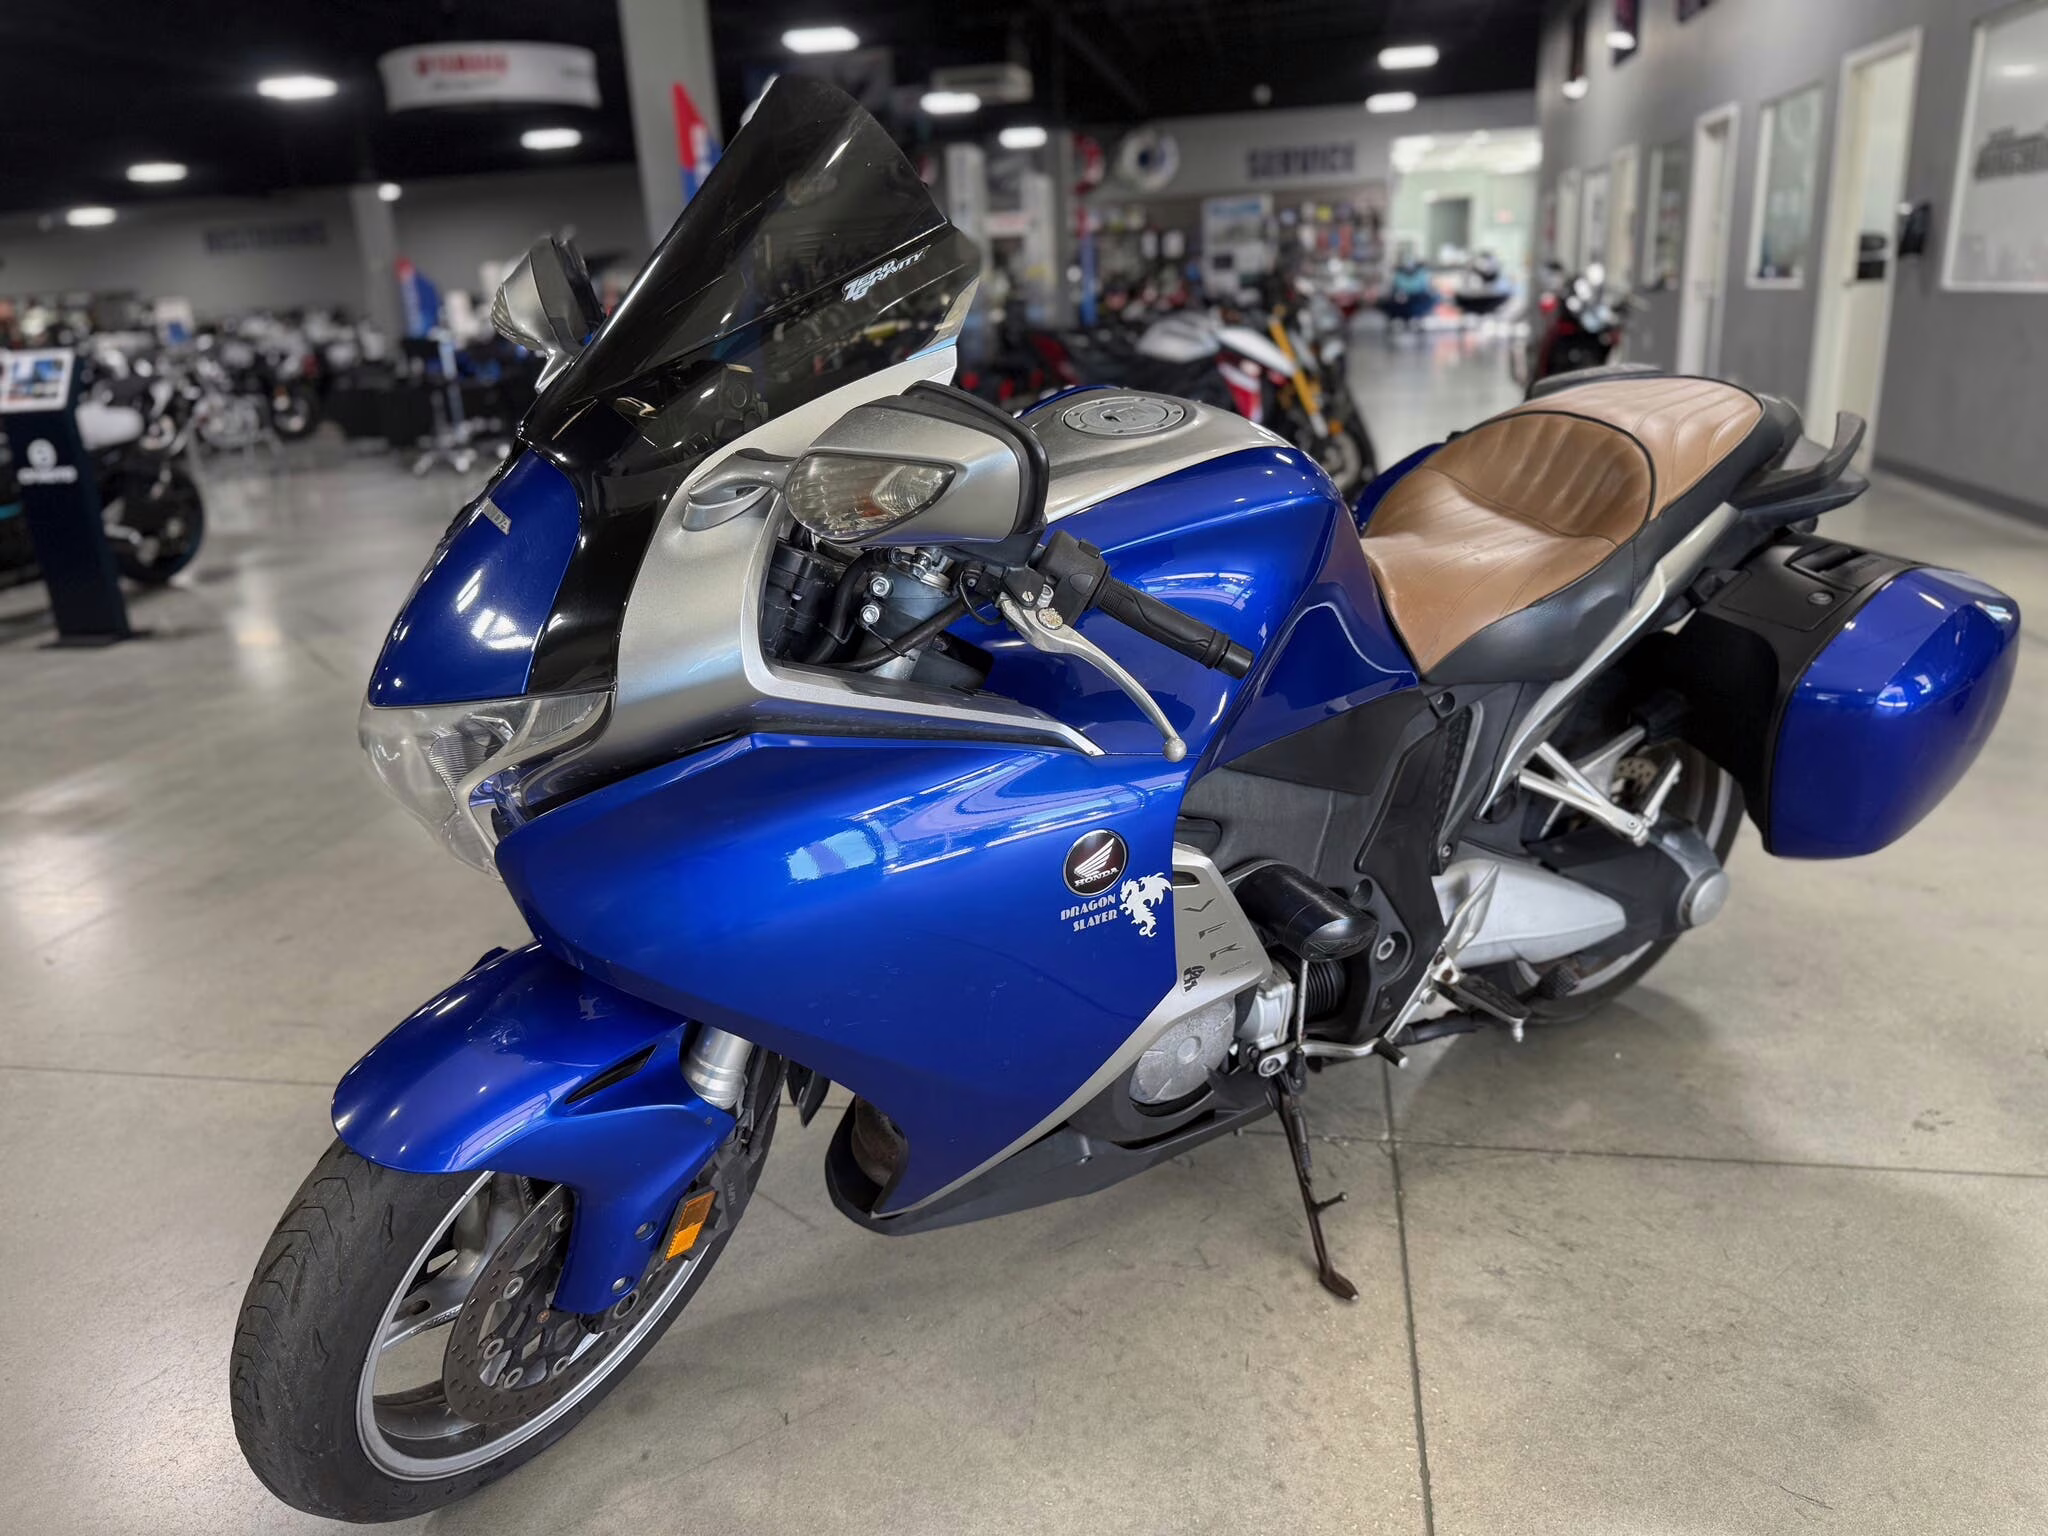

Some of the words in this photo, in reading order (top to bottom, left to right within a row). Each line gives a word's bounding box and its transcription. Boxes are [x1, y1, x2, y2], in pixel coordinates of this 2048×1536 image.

[844, 260, 897, 302] ZERO
[852, 251, 923, 302] GRAVITY
[1074, 867, 1119, 887] HONDA
[1060, 893, 1116, 921] DRAGON
[1072, 909, 1118, 932] SLAYER
